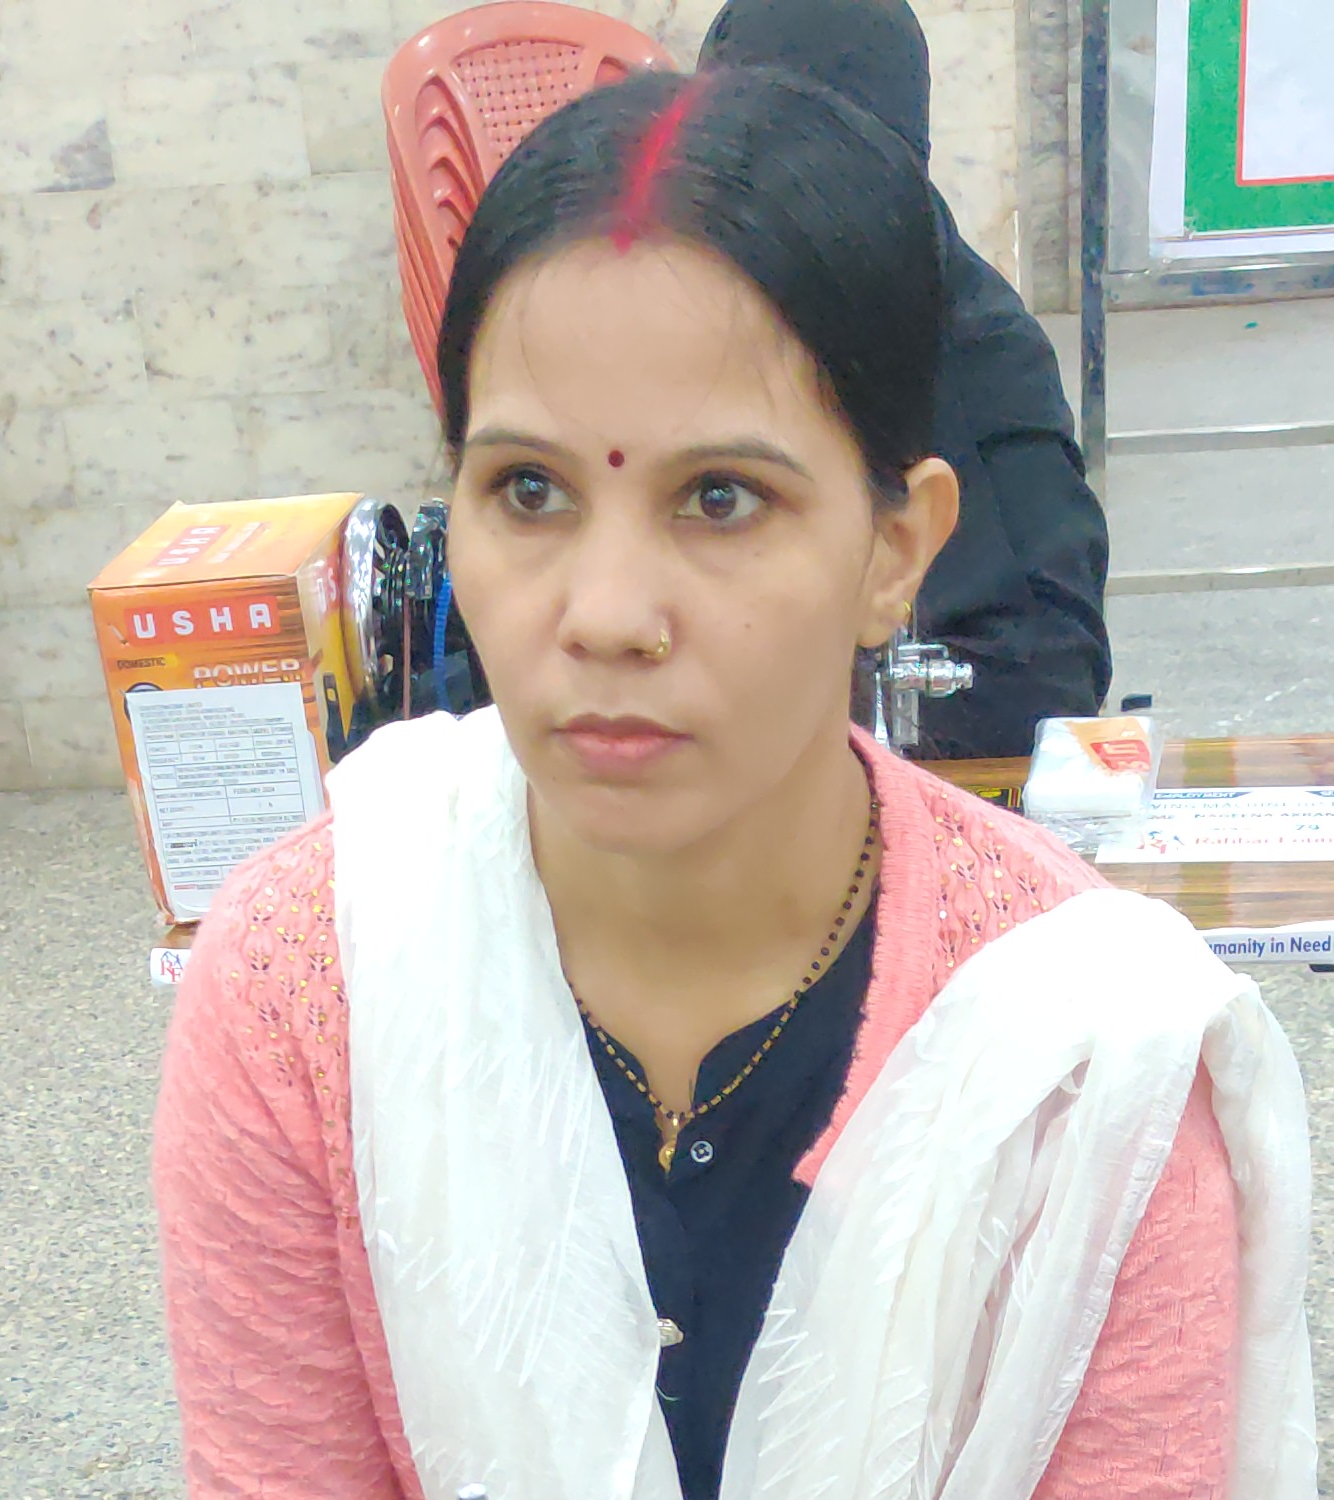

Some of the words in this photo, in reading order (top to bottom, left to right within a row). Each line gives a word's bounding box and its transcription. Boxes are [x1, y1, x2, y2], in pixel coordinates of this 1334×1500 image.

[133, 603, 272, 639] USHA
[1270, 936, 1285, 953] in
[1290, 935, 1331, 953] Need
